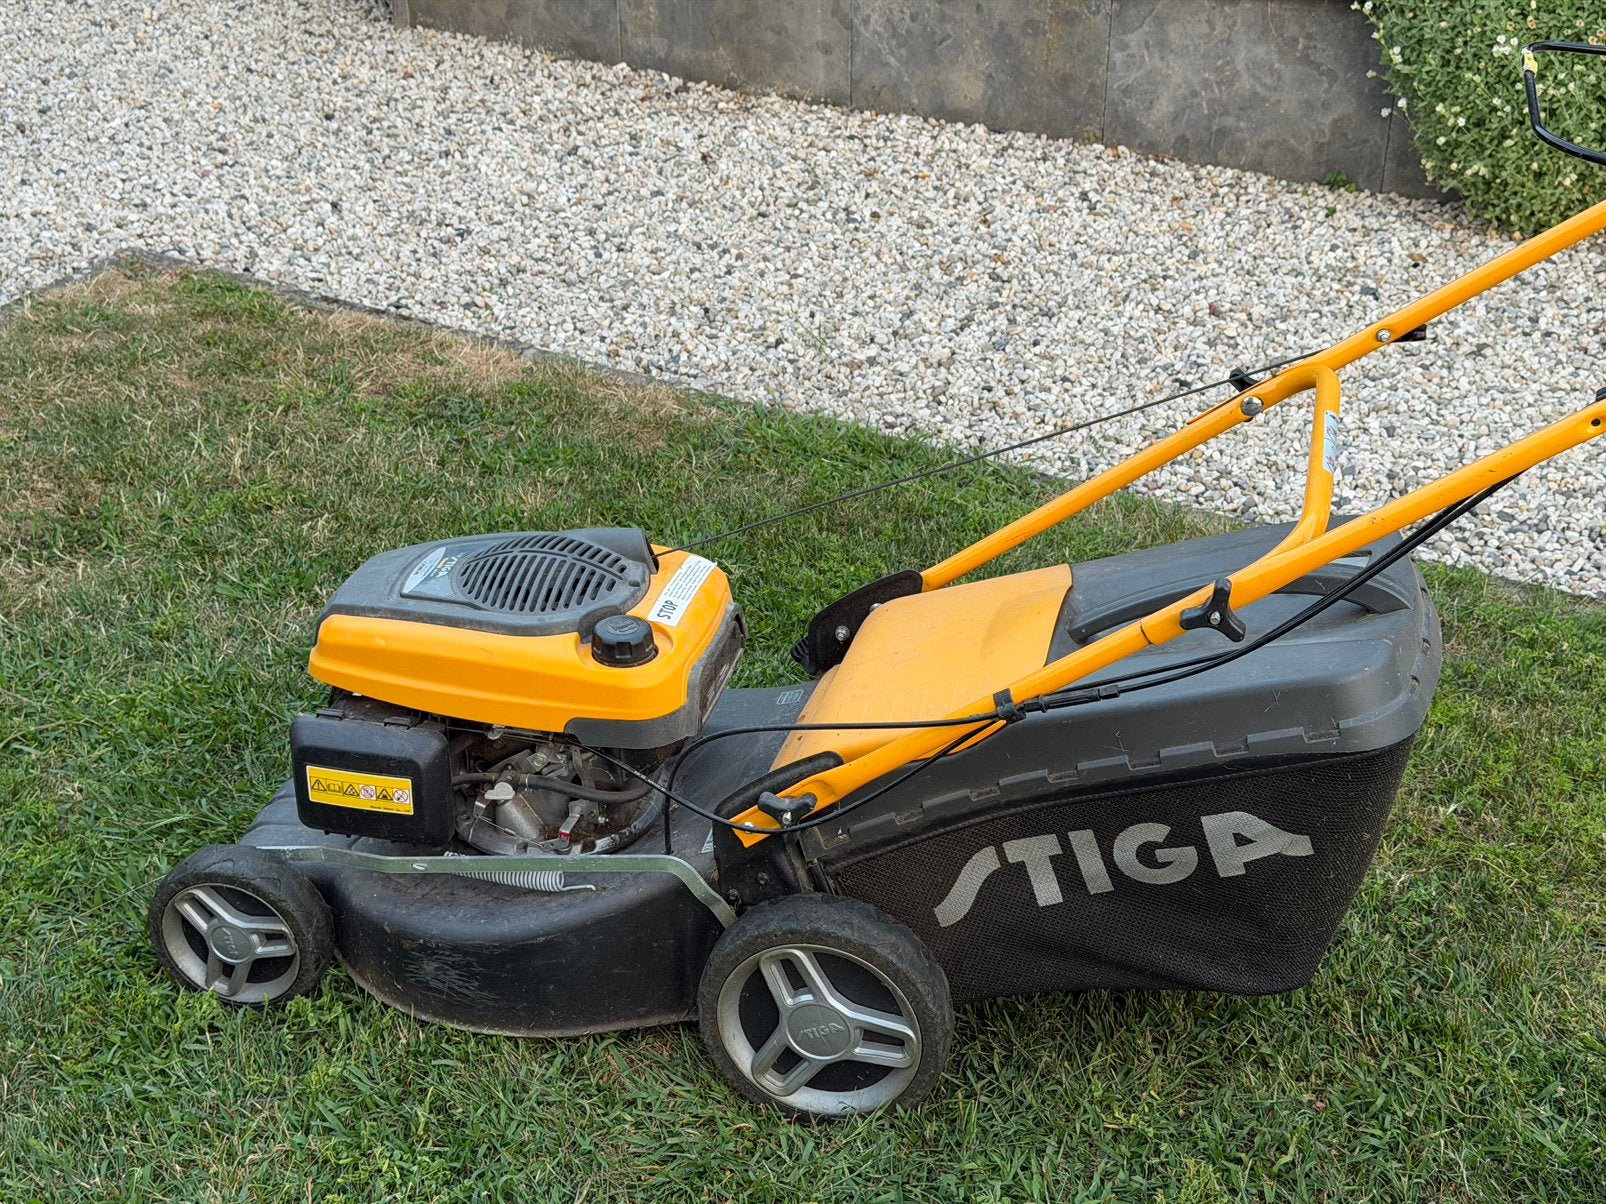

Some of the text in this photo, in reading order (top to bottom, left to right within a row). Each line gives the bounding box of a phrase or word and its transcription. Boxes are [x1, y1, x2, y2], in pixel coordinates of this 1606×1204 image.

[656, 599, 678, 620] STOP
[933, 811, 1314, 927] STIGA
[796, 1022, 845, 1042] STIGA
